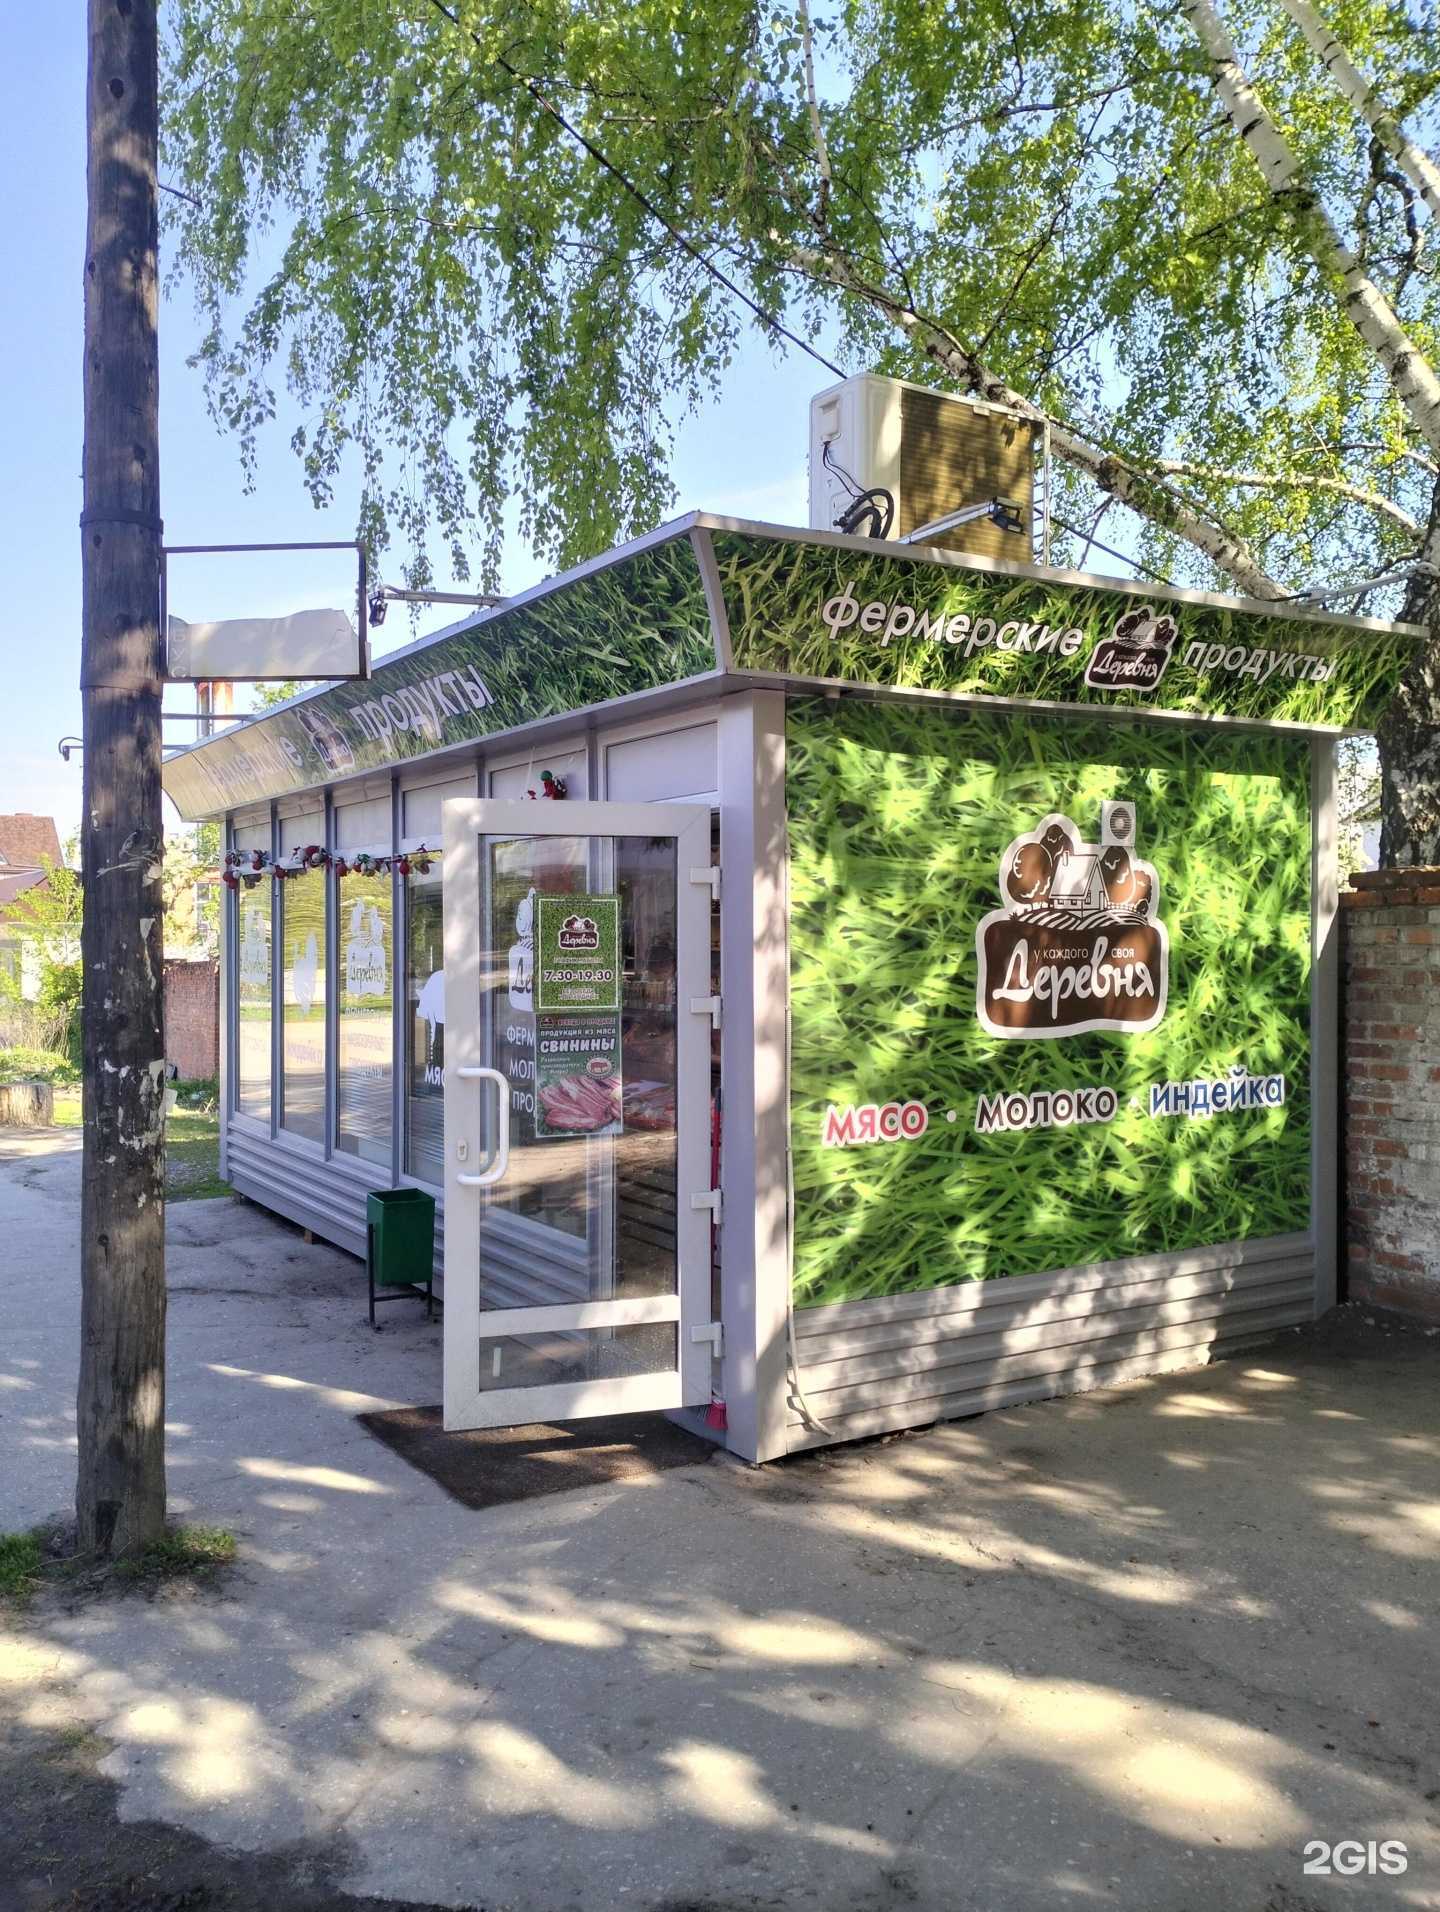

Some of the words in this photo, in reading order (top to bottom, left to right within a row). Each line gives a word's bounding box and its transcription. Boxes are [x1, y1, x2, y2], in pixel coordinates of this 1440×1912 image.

[822, 581, 1083, 657] фермерские
[1093, 650, 1158, 683] Деревня
[1182, 641, 1338, 686] продукты
[349, 664, 496, 751] продукты
[1043, 948, 1089, 961] каждого
[1111, 948, 1135, 958] своя
[544, 970, 613, 982] 7.30-19.30
[992, 935, 1155, 1021] Деревня
[541, 1028, 582, 1038] ПРОДУКЦИЯ
[597, 1027, 616, 1036] МЯСА
[541, 1037, 615, 1054] СВИНИНЫ
